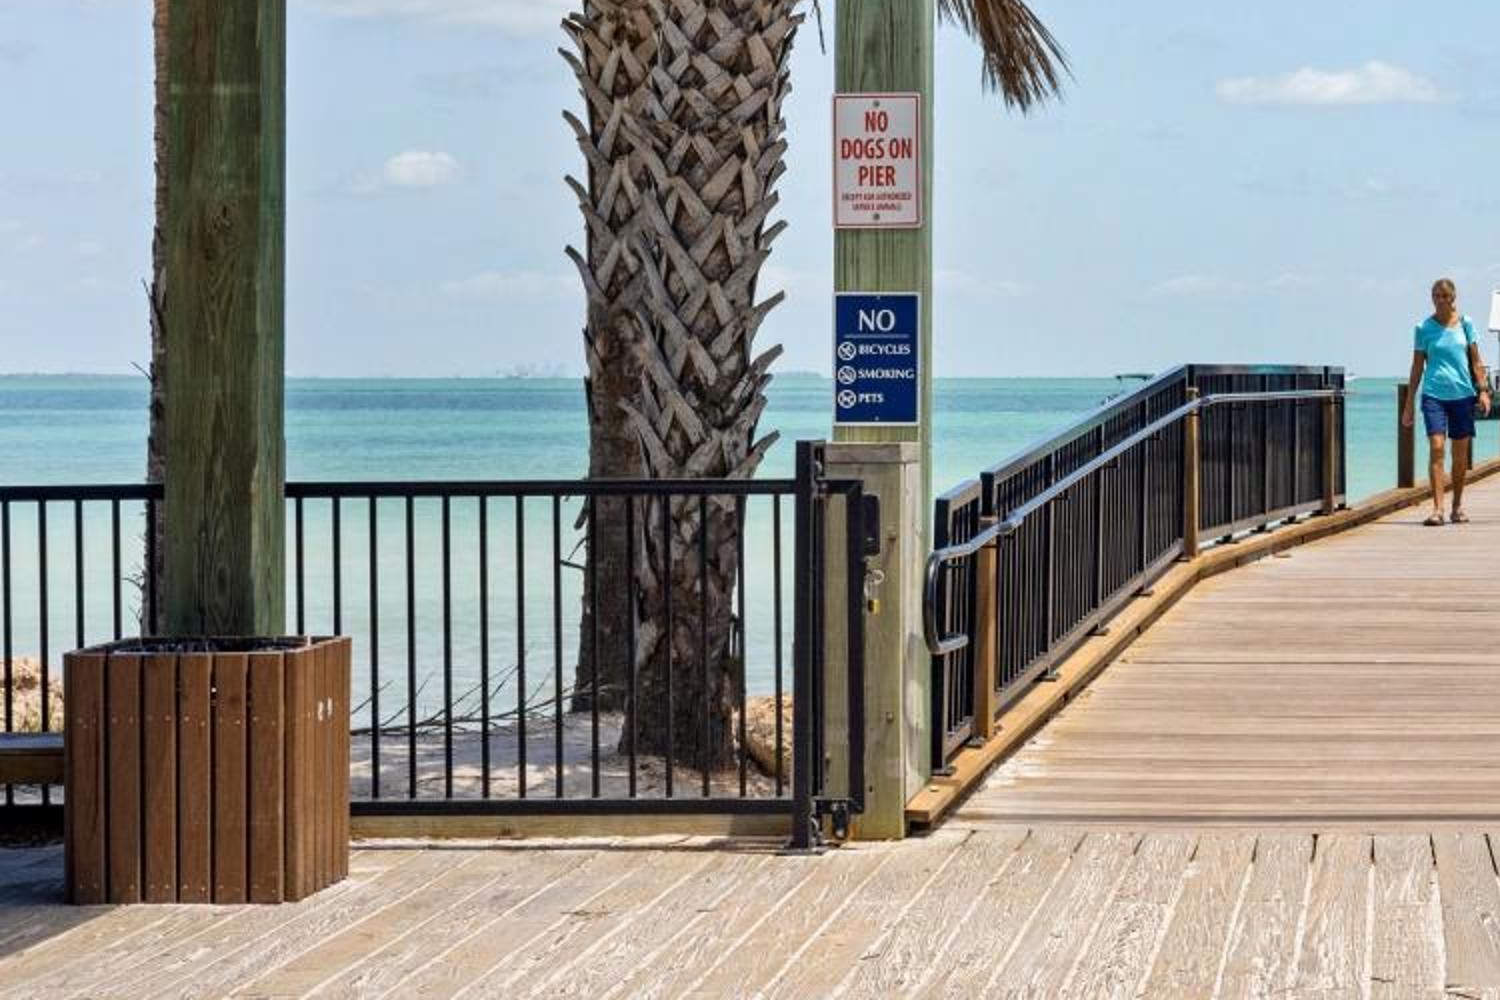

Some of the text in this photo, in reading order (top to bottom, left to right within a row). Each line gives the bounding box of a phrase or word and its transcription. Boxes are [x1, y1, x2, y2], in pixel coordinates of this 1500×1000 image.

[864, 111, 888, 132] NO
[841, 139, 912, 160] DOGS ON
[858, 166, 896, 186] PIER
[858, 309, 896, 332] NO
[858, 344, 911, 355] BICYCLES
[857, 368, 914, 379] SMOKING
